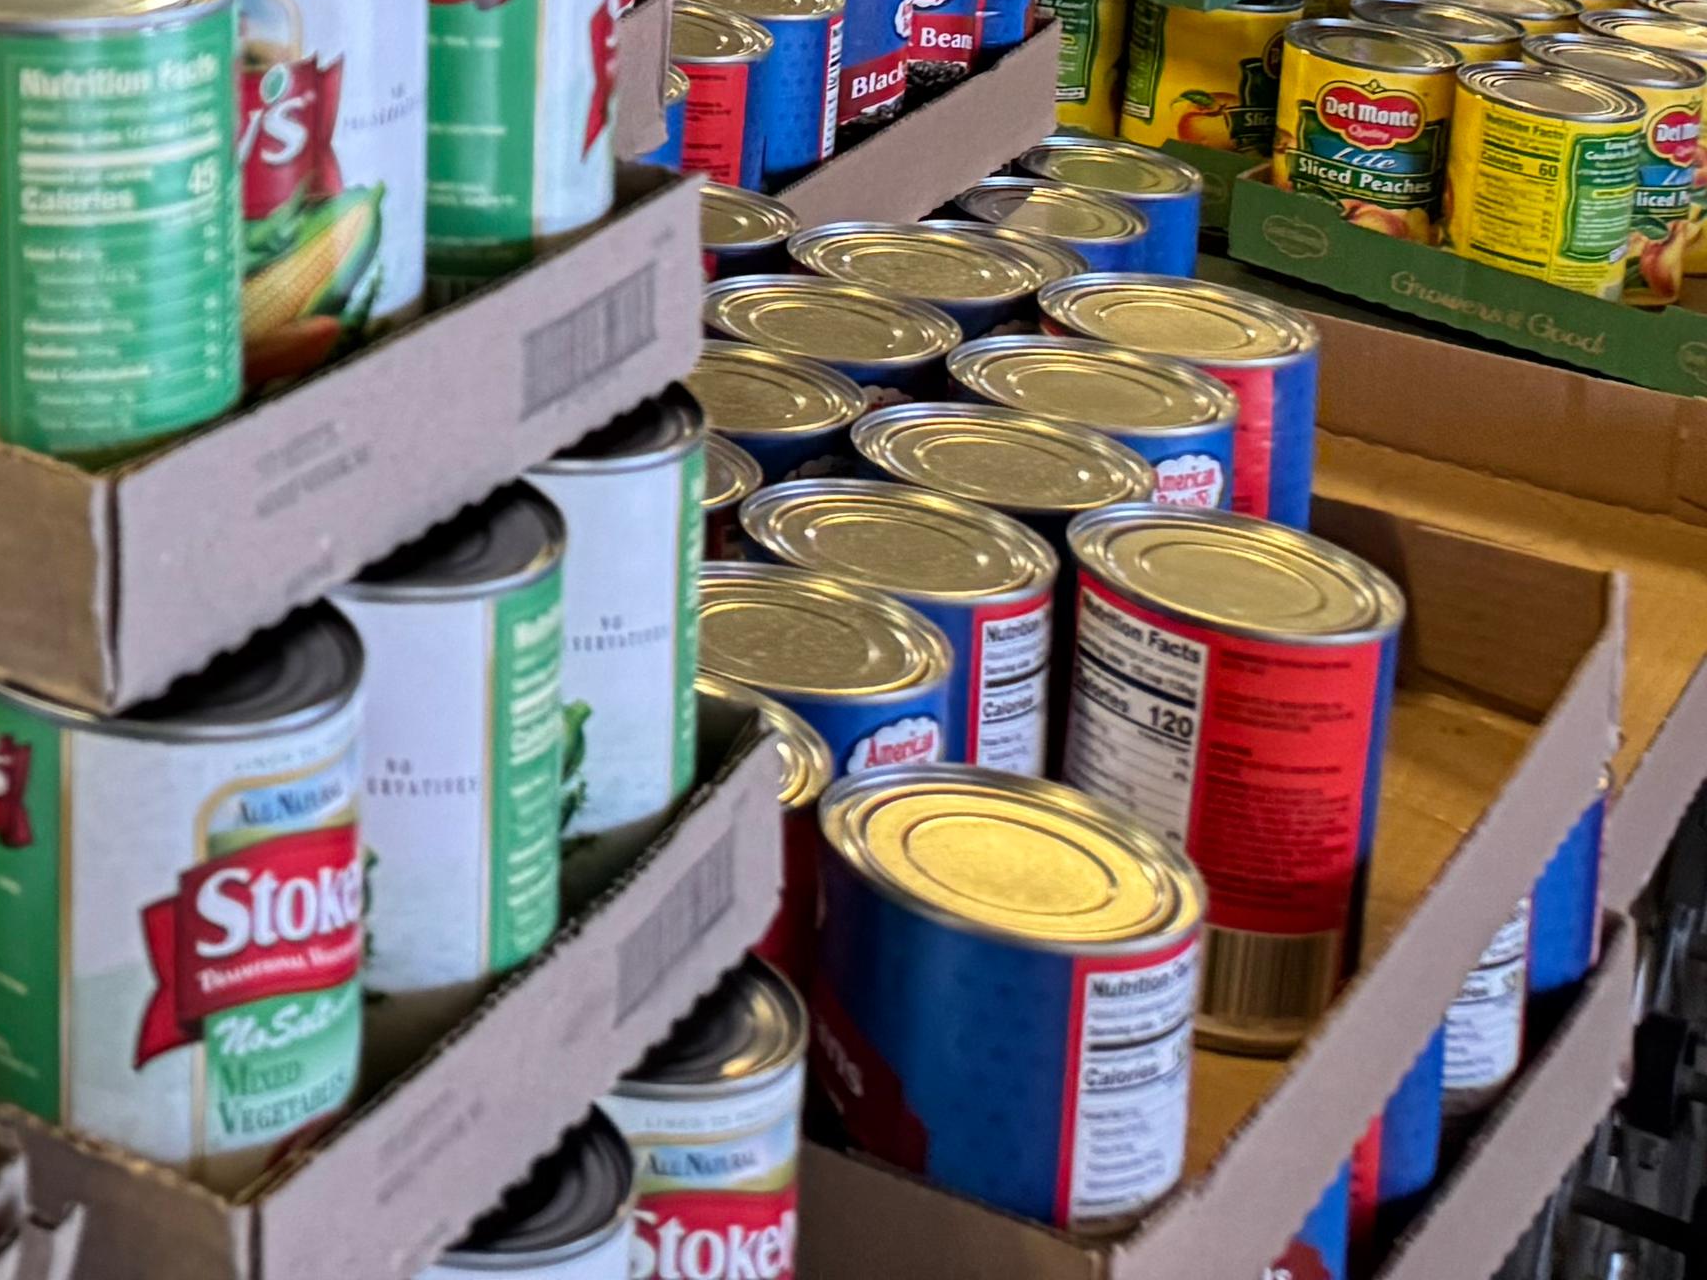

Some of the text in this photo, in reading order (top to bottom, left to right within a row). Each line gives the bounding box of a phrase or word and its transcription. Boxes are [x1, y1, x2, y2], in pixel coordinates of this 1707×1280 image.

[19, 59, 156, 97] Nutrition
[851, 55, 908, 99] Black
[1323, 95, 1419, 129] Del Monte
[1346, 122, 1392, 144] Quality
[1653, 121, 1680, 144] Del
[19, 155, 217, 211] Calories 45
[1297, 157, 1433, 197] Sliced Peaches
[1537, 161, 1559, 181] 60
[1147, 628, 1201, 665] Facts
[1148, 703, 1195, 738] 120
[217, 1056, 304, 1099] MIXED
[1084, 1064, 1159, 1087] Calories
